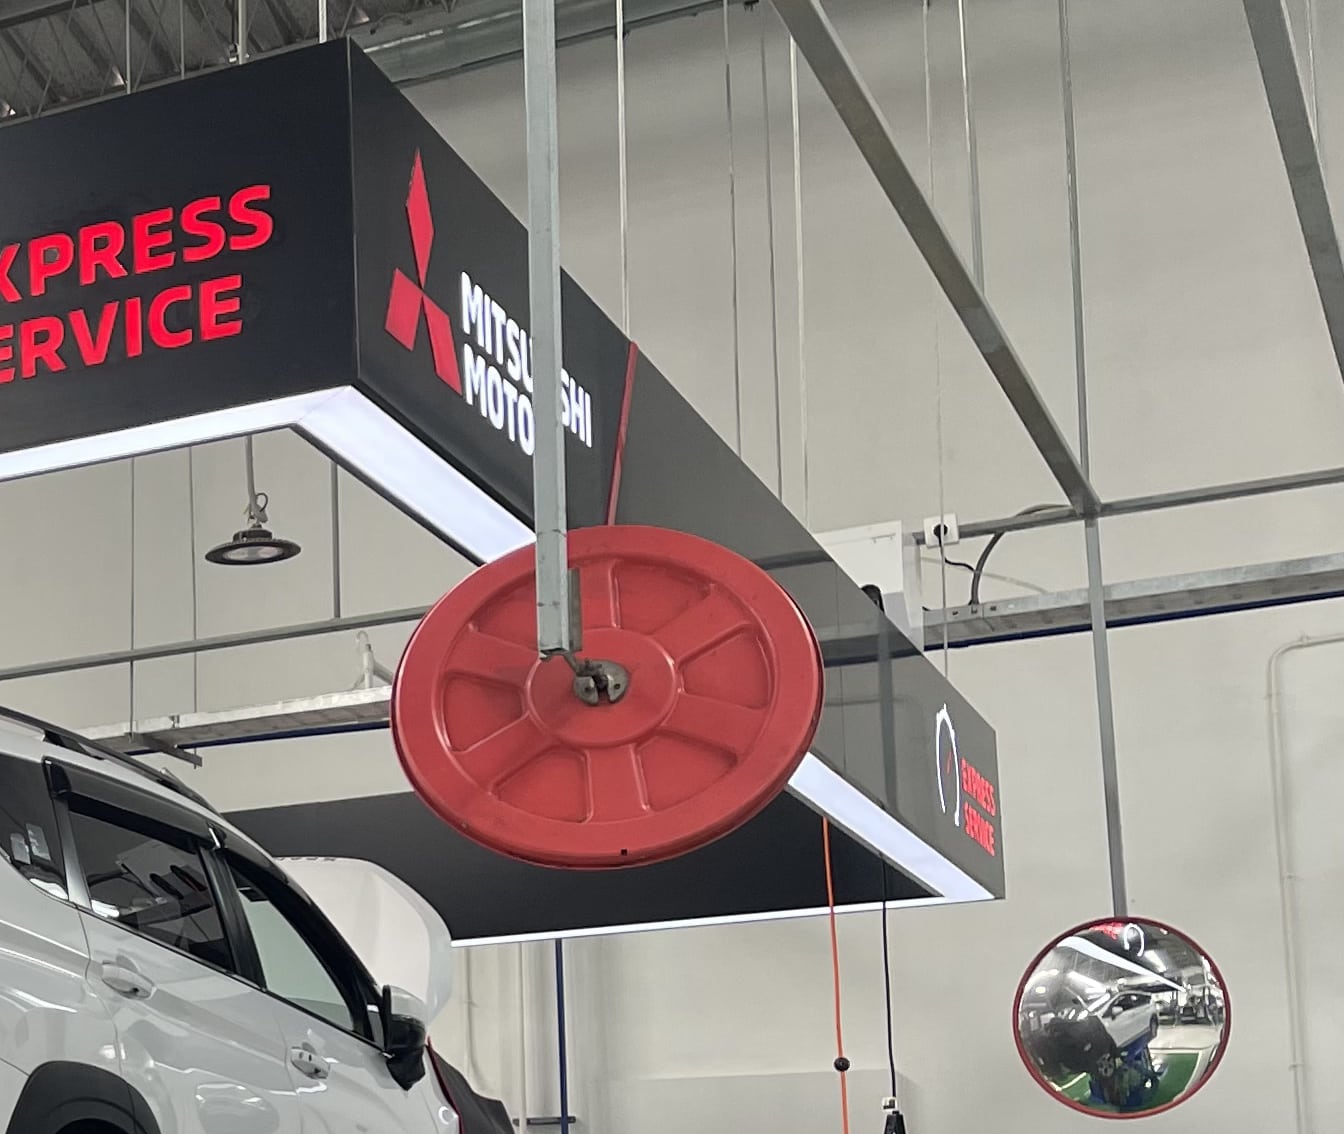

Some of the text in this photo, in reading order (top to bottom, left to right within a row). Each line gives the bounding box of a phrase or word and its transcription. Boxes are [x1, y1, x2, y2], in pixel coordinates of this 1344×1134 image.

[461, 271, 593, 448] MITSUSHI
[464, 343, 536, 456] MOTO
[960, 757, 996, 817] EXPRESS
[964, 801, 995, 857] SERVICE
